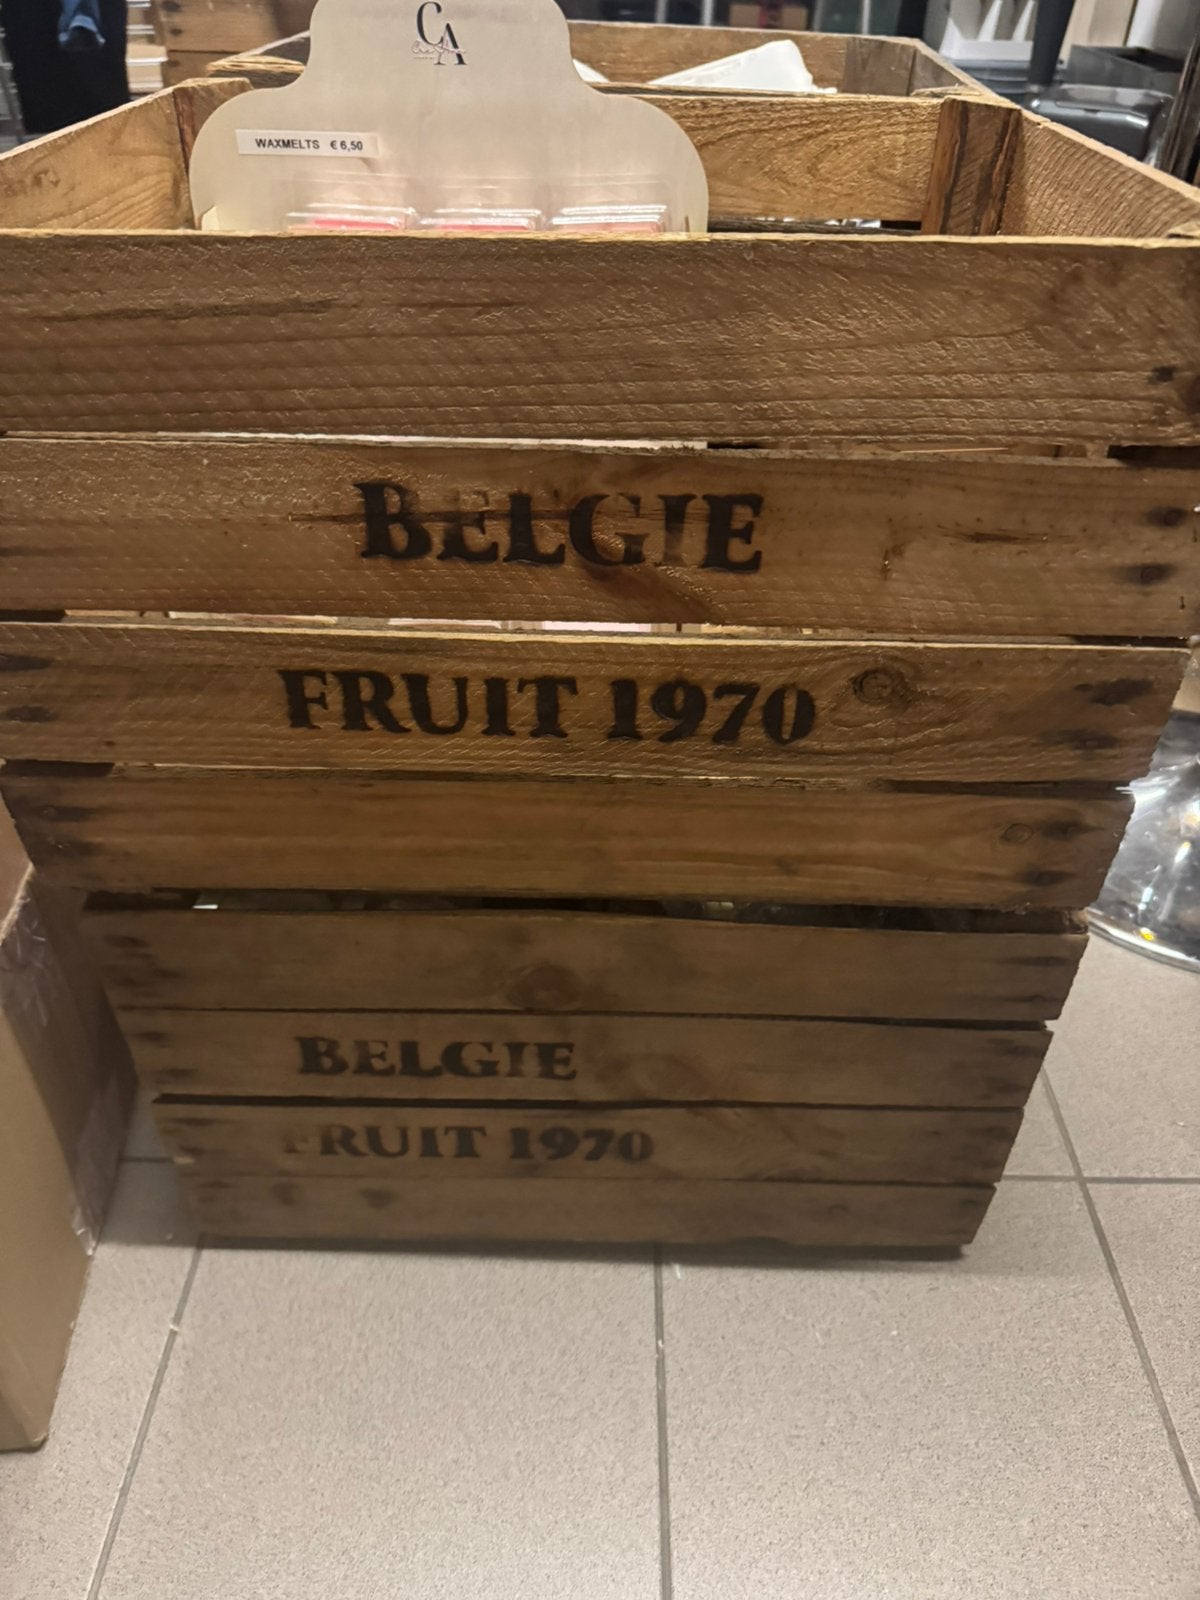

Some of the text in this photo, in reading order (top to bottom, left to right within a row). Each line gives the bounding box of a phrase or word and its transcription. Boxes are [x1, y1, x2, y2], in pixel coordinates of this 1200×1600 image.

[255, 138, 320, 150] WAXMELTS
[353, 480, 764, 573] BELGIE
[277, 668, 816, 746] FRUIT 1970
[295, 1036, 577, 1081] BELGIE
[509, 1126, 654, 1162] 1970
